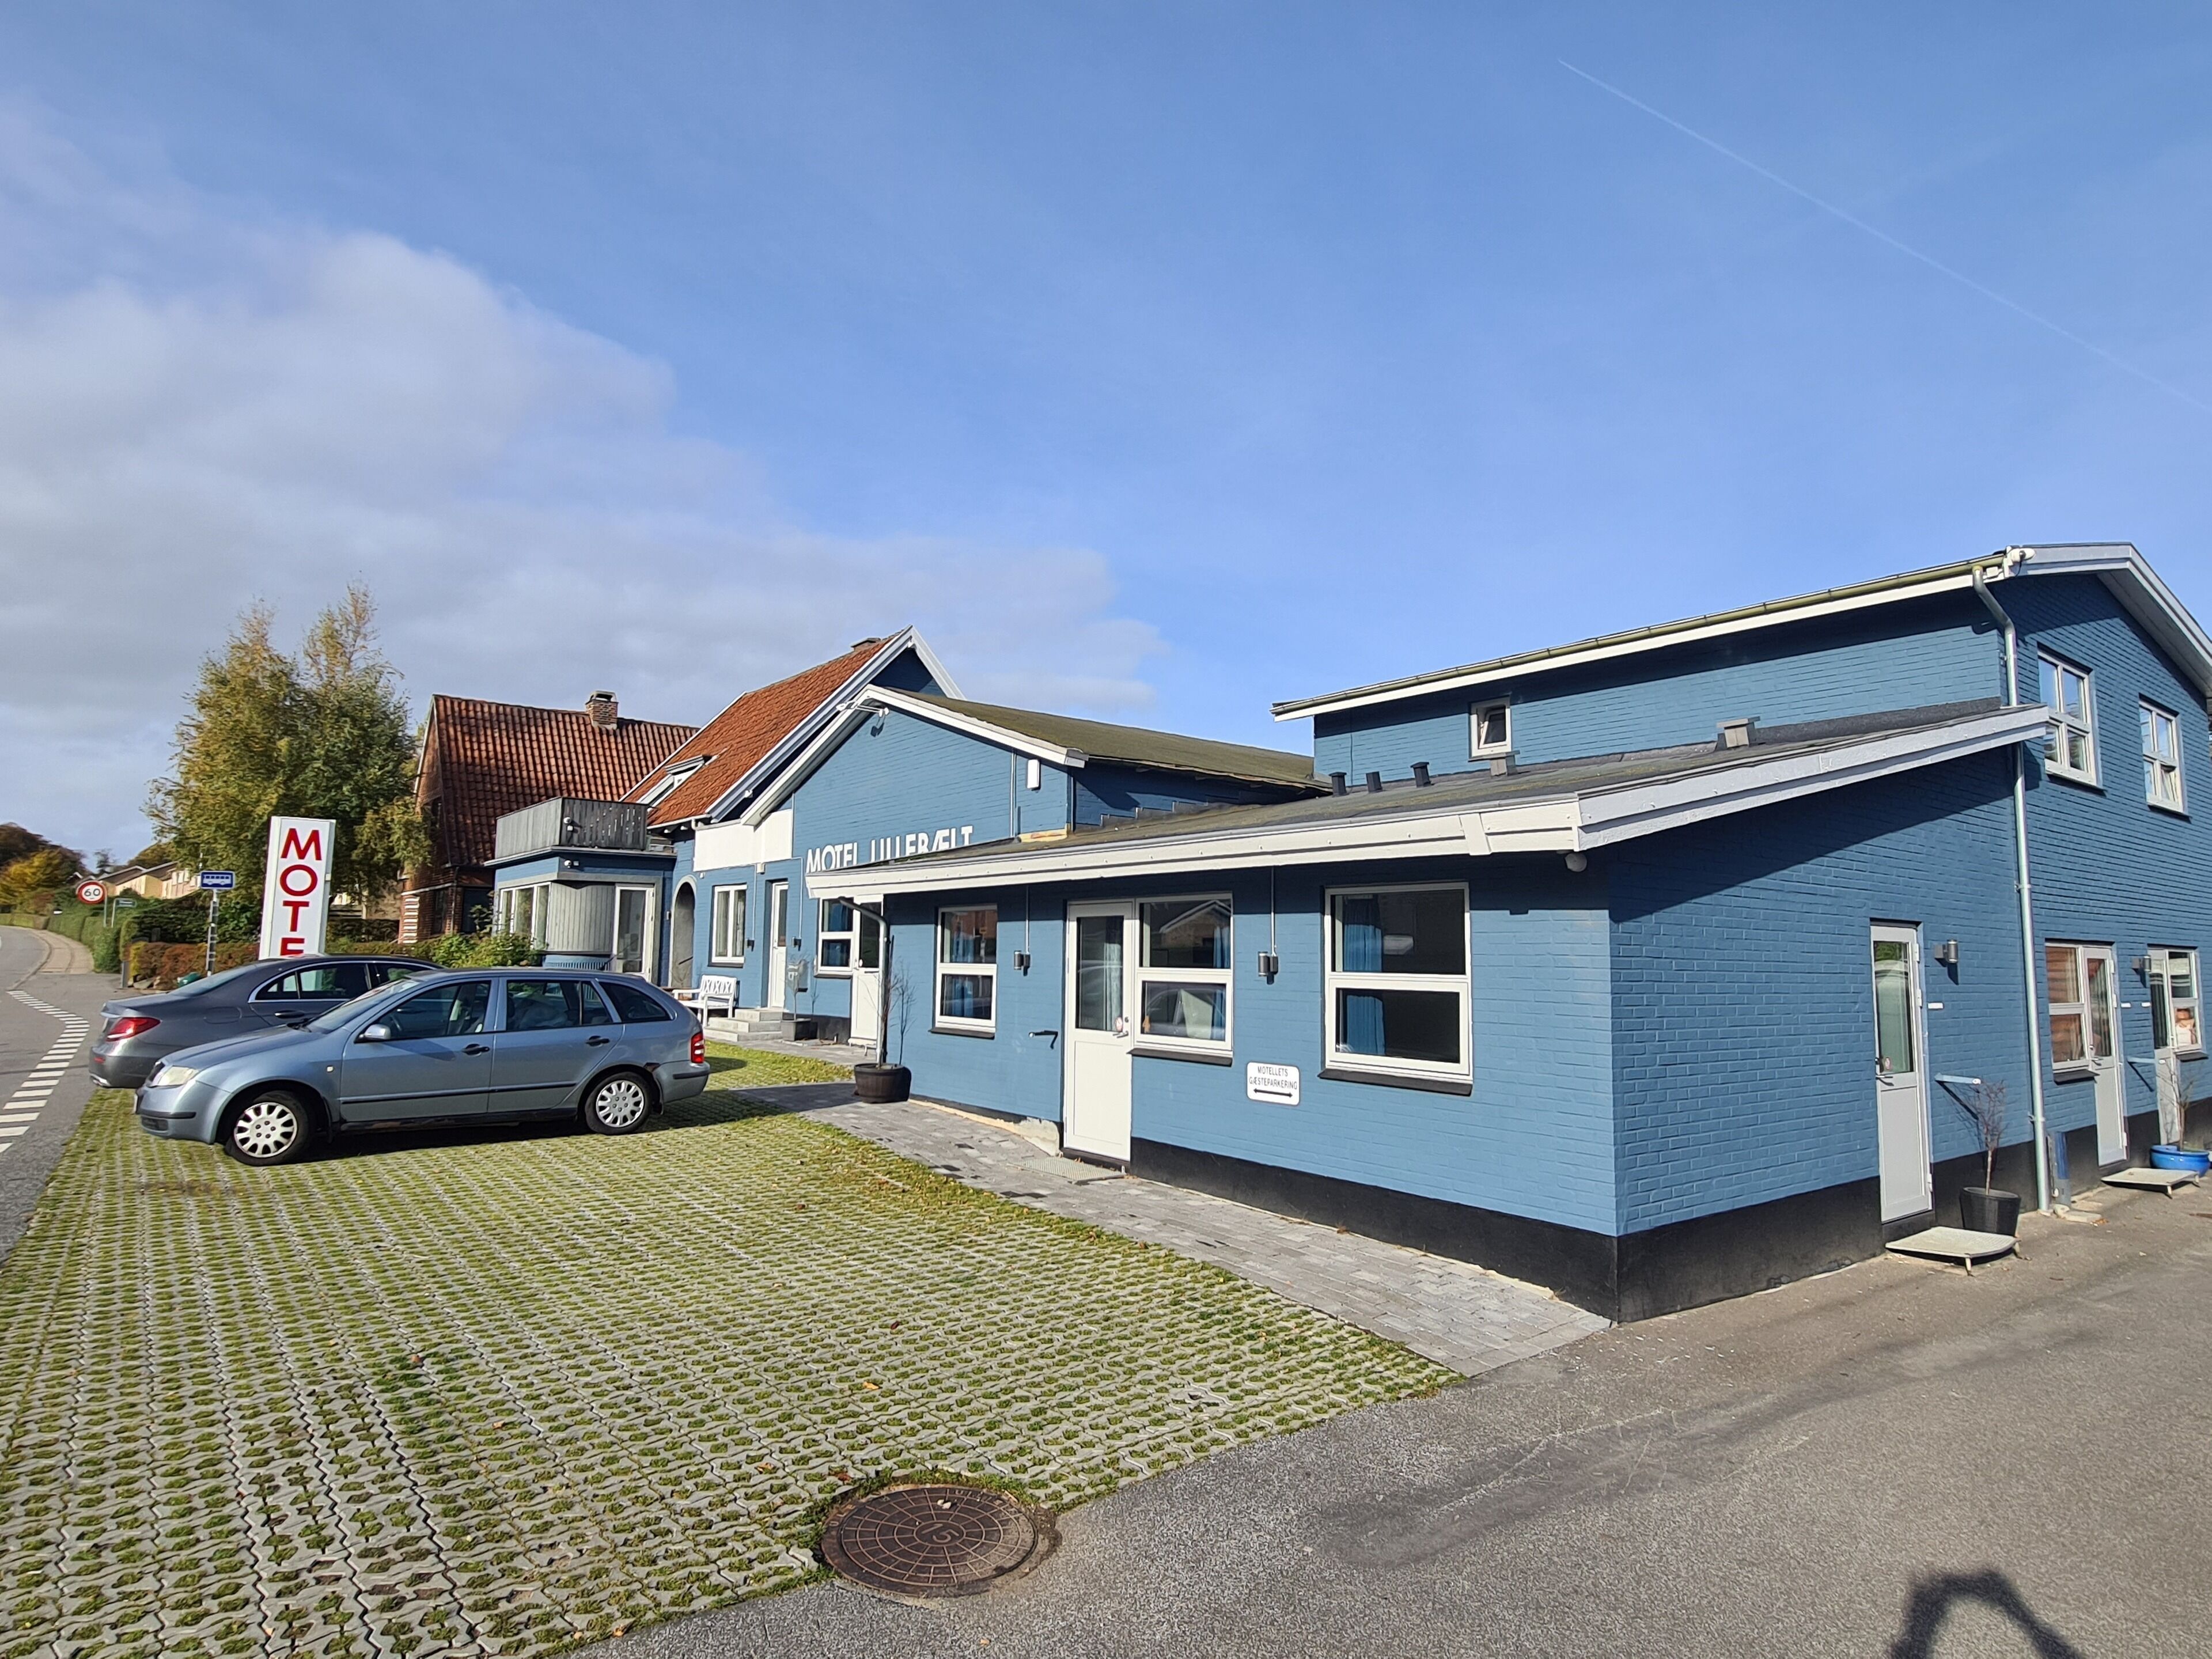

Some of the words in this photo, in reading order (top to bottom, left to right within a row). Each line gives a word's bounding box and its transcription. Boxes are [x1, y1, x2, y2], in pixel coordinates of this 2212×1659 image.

[806, 842, 858, 873] MOTEL
[84, 888, 101, 897] 60
[1257, 1066, 1288, 1077] MOTELLETS
[1249, 1077, 1297, 1090] GÆSTEPARKERING
[922, 1523, 960, 1543] 15
